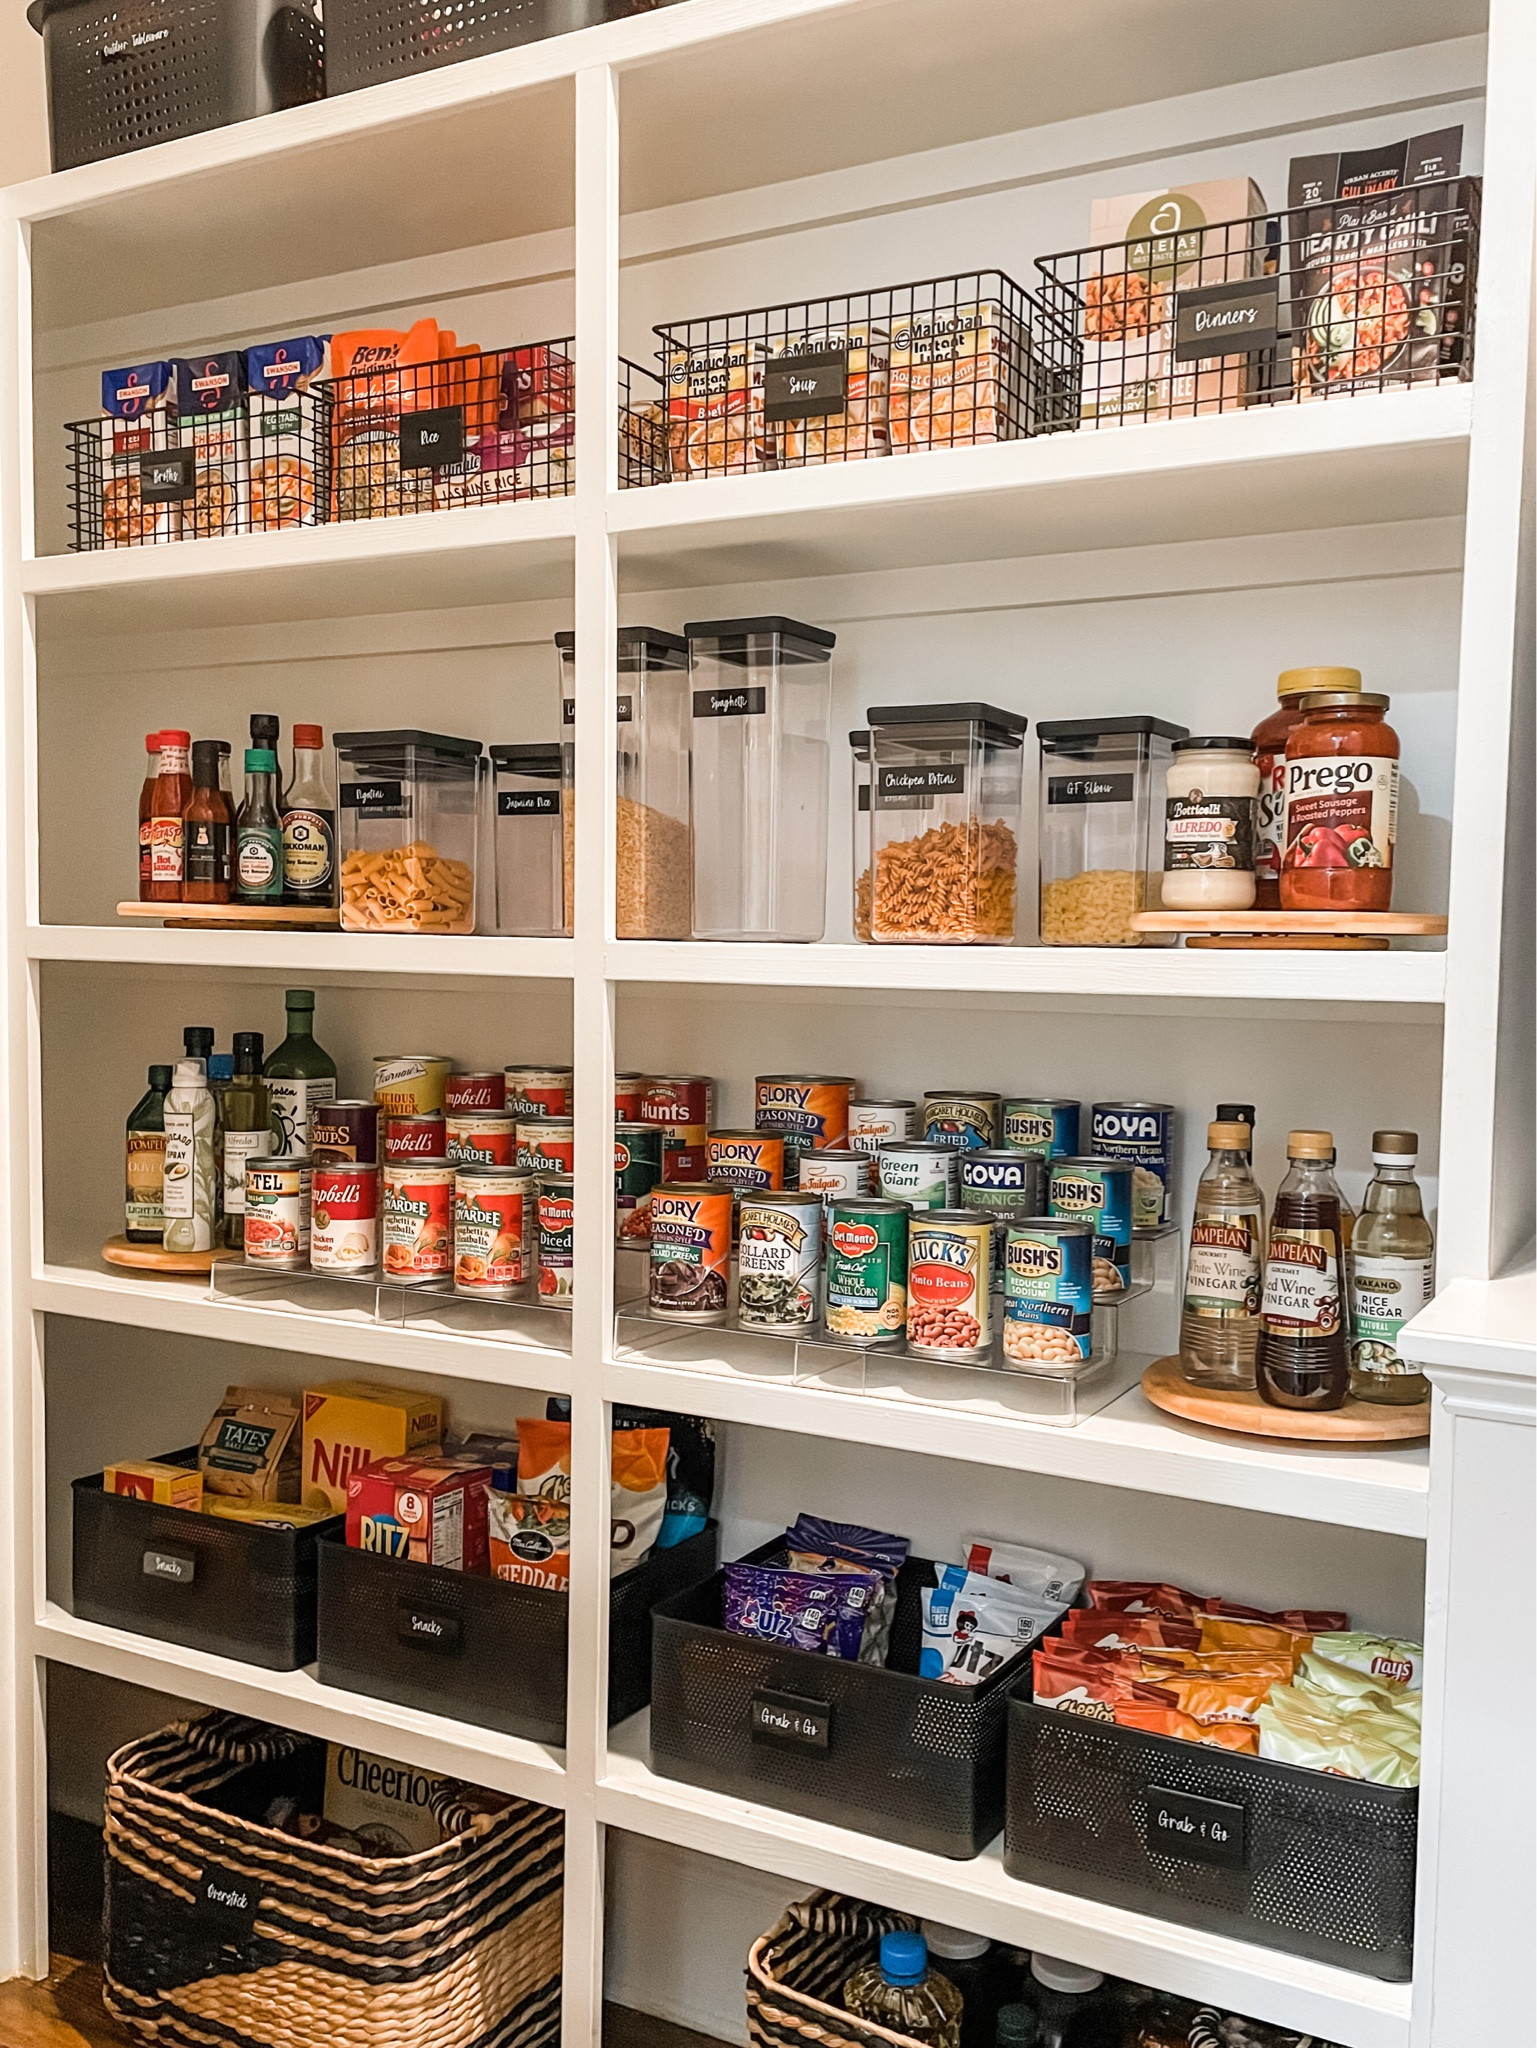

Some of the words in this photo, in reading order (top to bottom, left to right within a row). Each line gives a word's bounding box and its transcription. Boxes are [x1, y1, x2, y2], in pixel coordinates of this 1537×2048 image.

[1305, 187, 1319, 199] 20
[1195, 307, 1258, 332] Dinners
[351, 343, 400, 366] Ben's
[266, 364, 298, 375] SWANSON
[194, 375, 228, 389] SWANSON
[789, 376, 817, 395] Soup
[119, 387, 148, 399] SWANSON
[421, 430, 439, 445] Rice
[711, 695, 747, 712] Spaghetti
[886, 773, 925, 788] Chickpea
[1289, 763, 1372, 794] Prego
[1067, 783, 1081, 795] GF
[1085, 782, 1113, 794] Elbow
[537, 797, 551, 807] Rice
[1296, 802, 1317, 813] Sweet
[1319, 798, 1357, 808] Sausage
[1297, 810, 1328, 821] Roasted
[1330, 807, 1366, 817] Peppers
[1173, 821, 1222, 833] ALFREDO
[759, 1086, 812, 1109] GLORY
[757, 1111, 818, 1128] SEASONED
[1094, 1114, 1157, 1137] GOYA
[858, 1124, 890, 1137] Tailgate
[1005, 1118, 1052, 1138] BUSH'S
[934, 1134, 969, 1146] FRIED
[709, 1143, 763, 1165] GLORY
[881, 1157, 919, 1172] Green
[708, 1167, 766, 1183] SEASONED
[883, 1173, 920, 1187] Giant
[964, 1163, 1021, 1186] GOYA
[808, 1178, 840, 1192] Tailgate
[1052, 1182, 1101, 1203] BUSH'S
[961, 1190, 1026, 1206] ORGANICS
[128, 1206, 151, 1215] LIGHT
[652, 1198, 701, 1222] GLORY
[763, 1211, 796, 1232] HOLMES
[541, 1232, 571, 1247] Diced
[835, 1231, 845, 1242] Del
[846, 1233, 874, 1244] Monte
[672, 1251, 699, 1261] GREENS
[912, 1241, 970, 1267] LUCK'S
[1008, 1245, 1059, 1270] BUSH'S
[741, 1257, 786, 1270] GREENS
[1016, 1266, 1041, 1274] BEST
[1214, 1262, 1247, 1277] Wine
[838, 1275, 865, 1286] WHOLE
[911, 1272, 933, 1286] Pinto
[936, 1277, 969, 1288] Beans
[1011, 1278, 1050, 1289] REDUCED
[1190, 1276, 1237, 1290] VINEGAR
[1281, 1279, 1315, 1296] Wine
[830, 1282, 852, 1294] KERNEL
[854, 1284, 878, 1296] CORN
[1011, 1286, 1047, 1297] SODIUM
[1362, 1295, 1388, 1306] RICE
[1017, 1310, 1040, 1320] Beans
[1020, 1301, 1069, 1316] Northern
[1361, 1320, 1388, 1330] NATURAL
[412, 1413, 438, 1433] Nilla
[406, 1496, 415, 1510] 8
[361, 1515, 410, 1558] RITZ
[156, 1557, 182, 1576] Snacks
[852, 1588, 864, 1597] 140
[412, 1616, 442, 1636] Snacks
[932, 1615, 947, 1625] FREE
[761, 1708, 791, 1730] Grab
[803, 1718, 819, 1736] Go
[1158, 1811, 1195, 1834] Grab
[1211, 1823, 1230, 1842] Go
